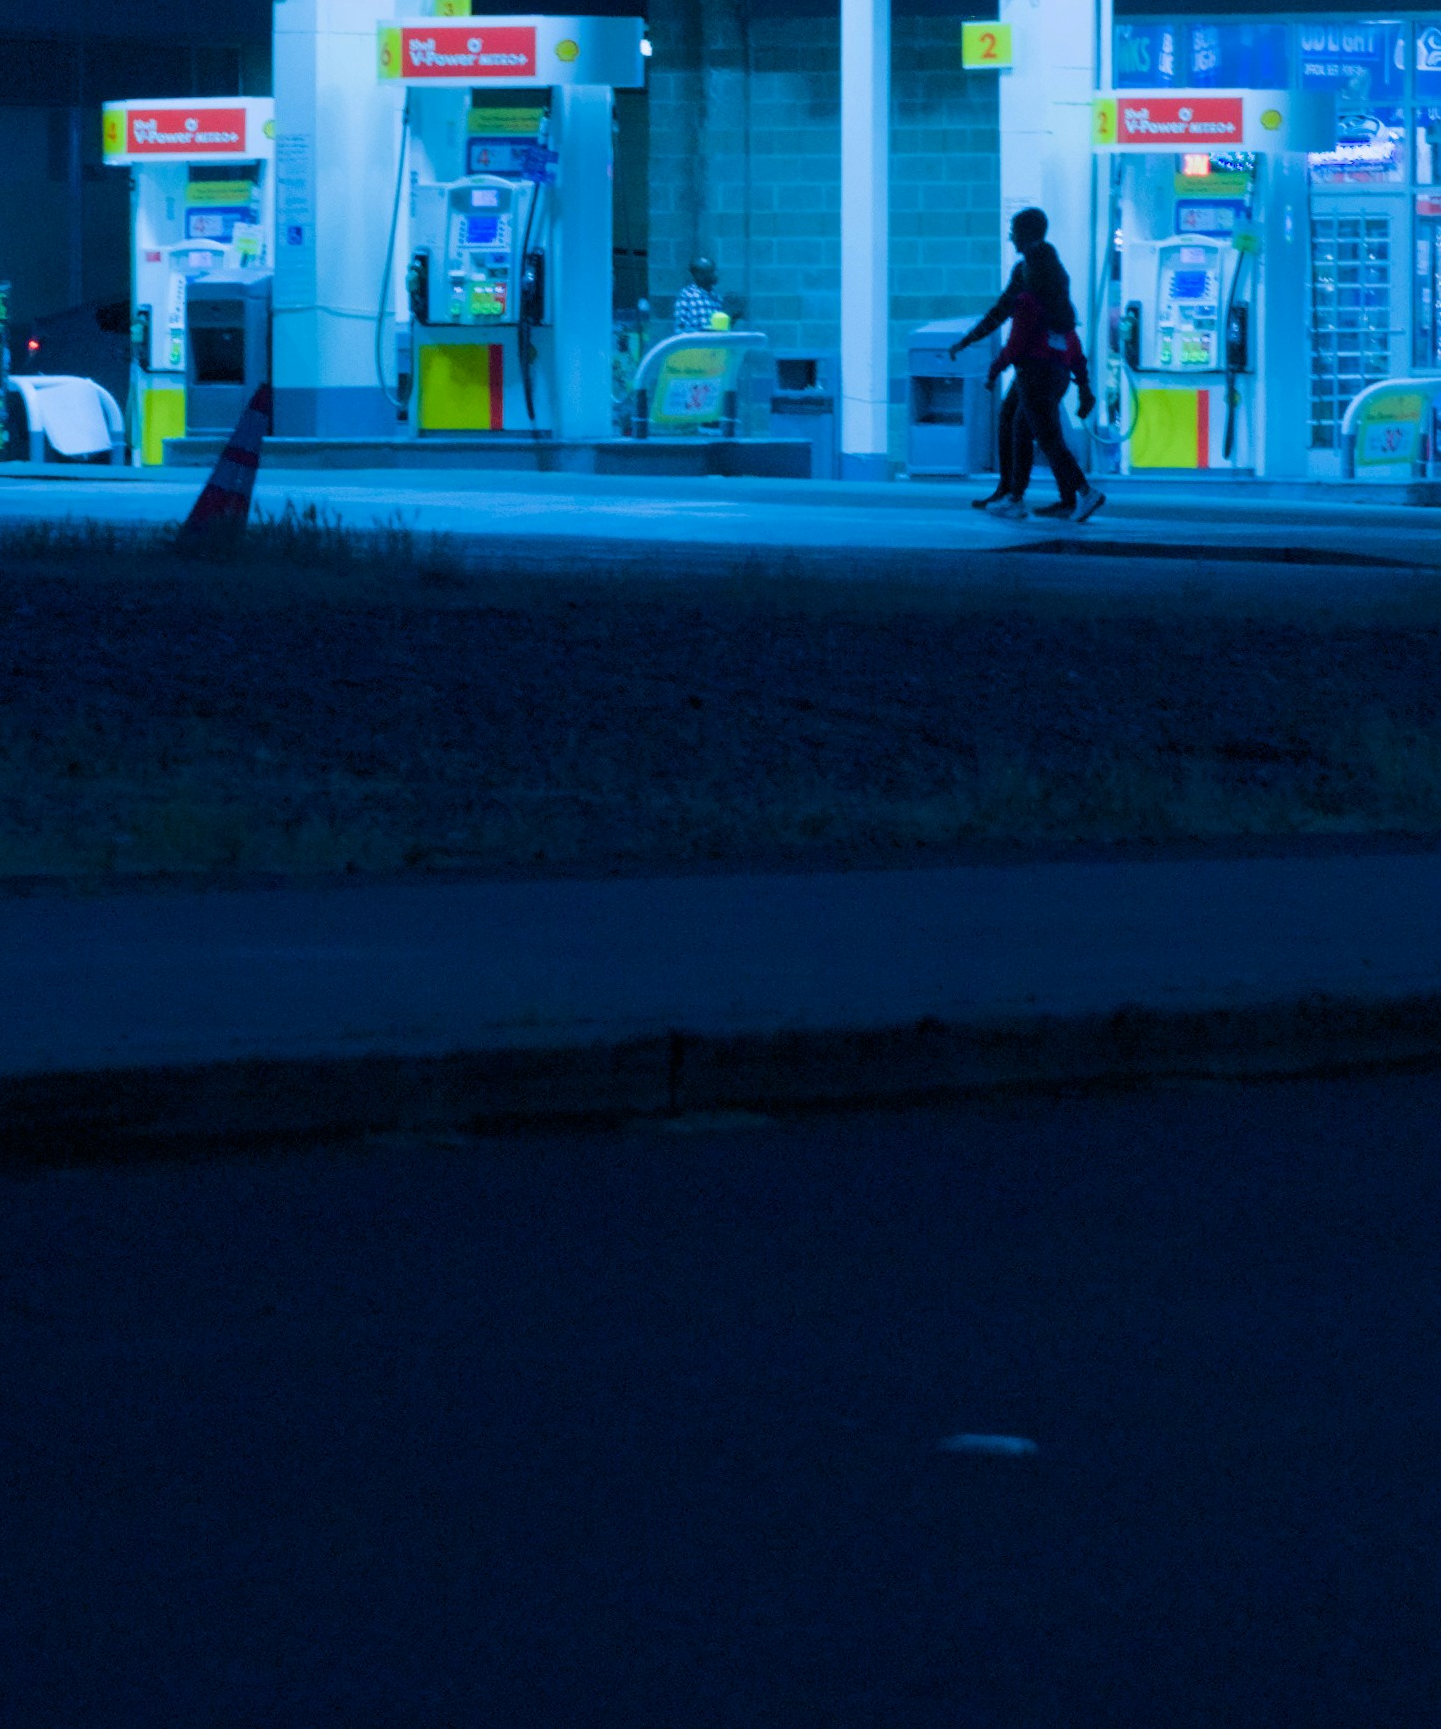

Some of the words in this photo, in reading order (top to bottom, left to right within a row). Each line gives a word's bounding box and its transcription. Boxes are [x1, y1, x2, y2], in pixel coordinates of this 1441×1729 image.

[381, 42, 391, 66] 6
[979, 32, 998, 59] 2
[1098, 110, 1107, 134] 2
[1125, 120, 1188, 134] V-Power
